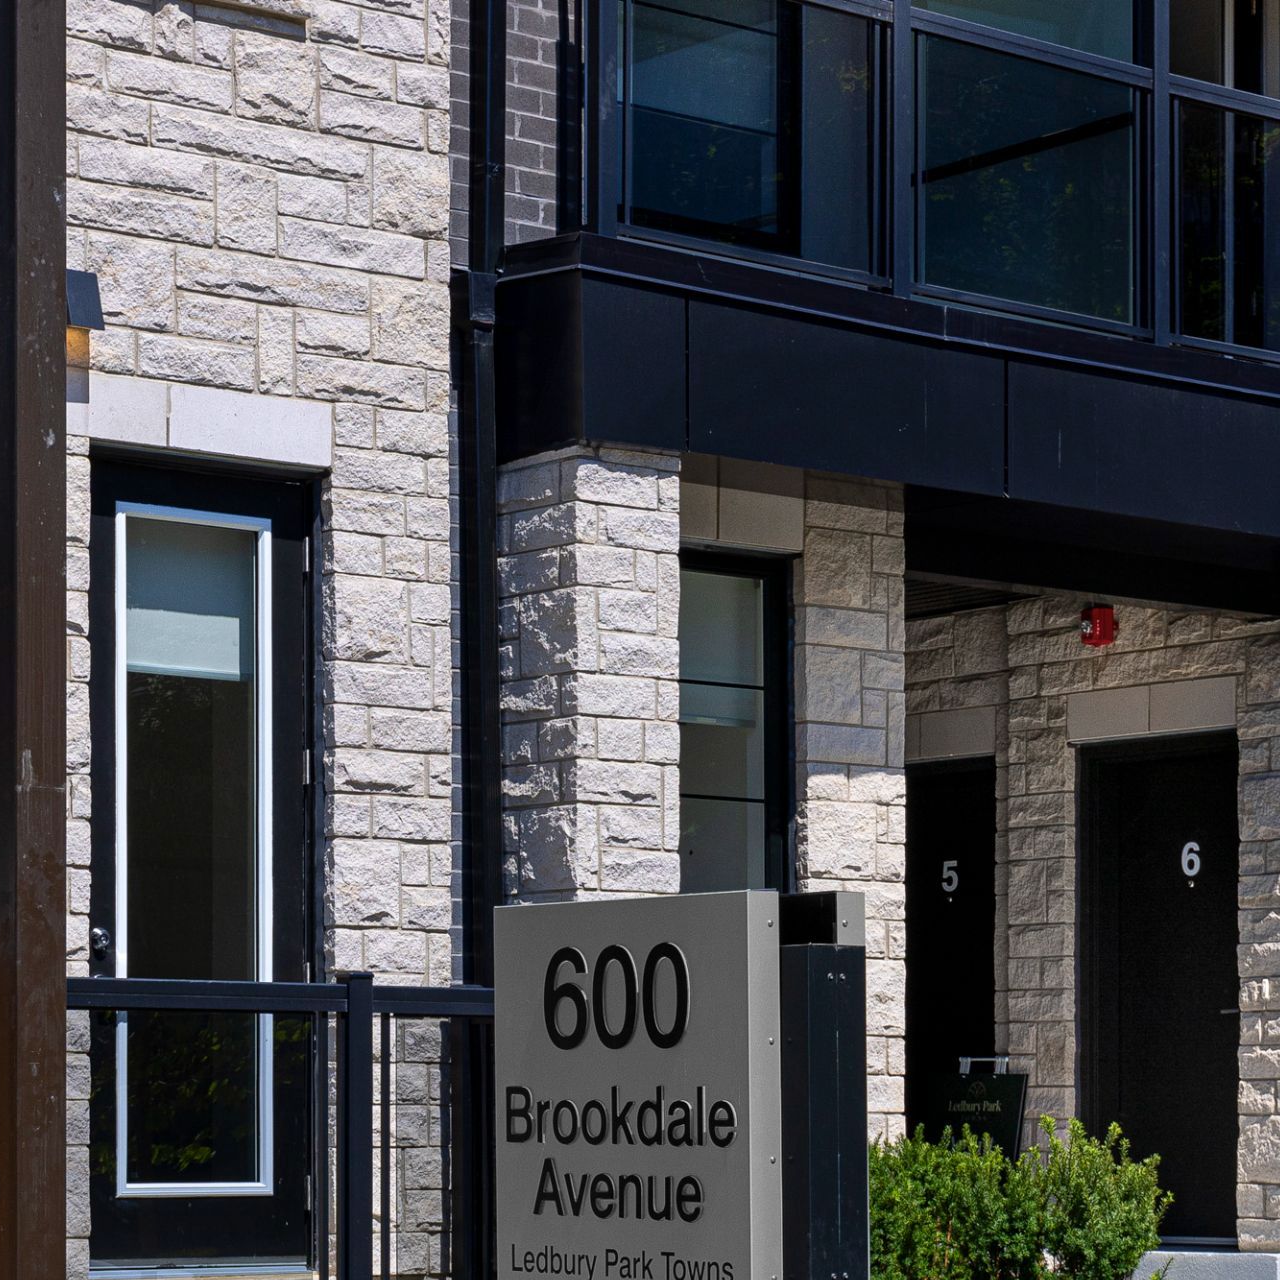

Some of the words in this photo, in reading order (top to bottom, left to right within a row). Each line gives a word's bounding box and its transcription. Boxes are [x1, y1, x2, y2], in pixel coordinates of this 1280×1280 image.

[941, 860, 958, 892] 5
[1181, 842, 1201, 876] 6
[543, 942, 690, 1050] 600
[505, 1085, 737, 1148] Brookdale
[982, 1099, 1002, 1113] Park
[532, 1158, 703, 1222] Avenue
[605, 1249, 653, 1280] Park
